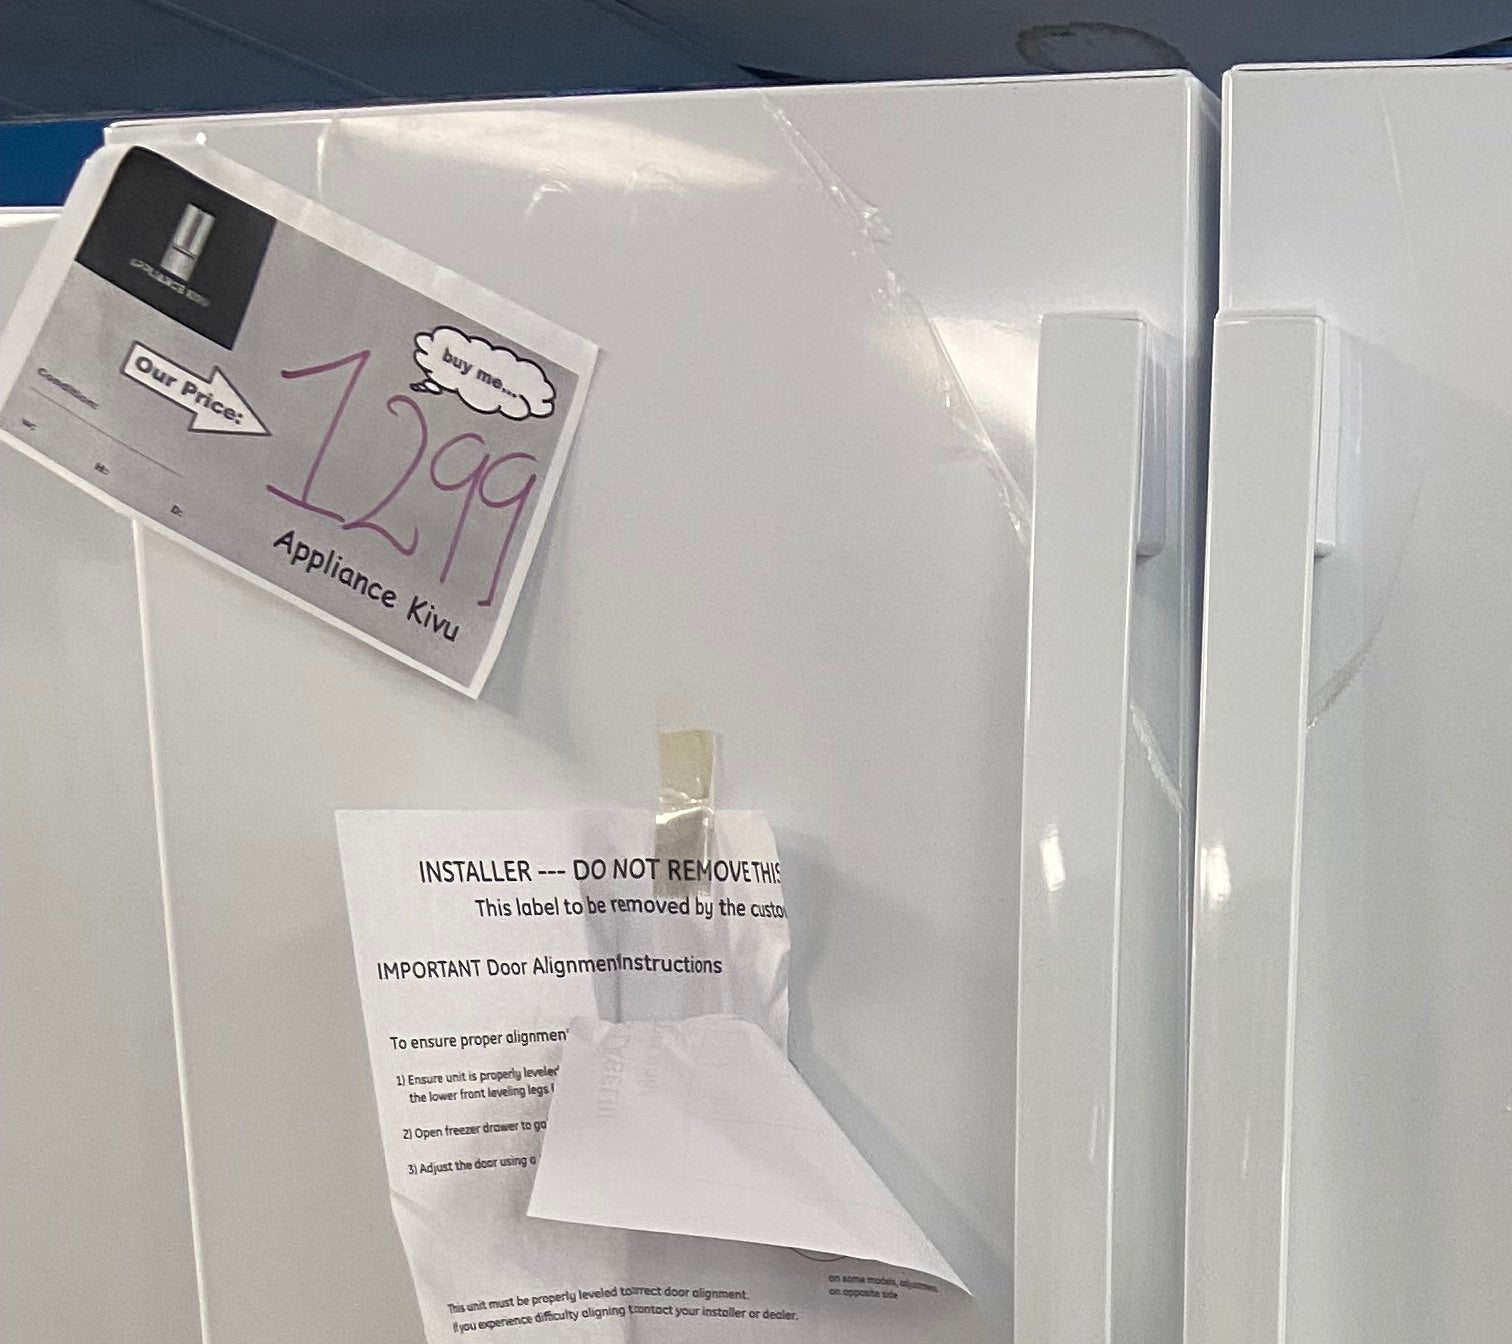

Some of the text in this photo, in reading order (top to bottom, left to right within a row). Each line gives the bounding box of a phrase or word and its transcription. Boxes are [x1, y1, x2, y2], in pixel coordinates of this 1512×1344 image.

[442, 347, 474, 375] buy
[135, 356, 244, 426] Our Price:
[266, 349, 540, 607] 1299
[273, 530, 461, 643] Appliance Kivu
[419, 860, 533, 883] INSTALLER
[573, 858, 607, 881] DO
[613, 857, 661, 880] NOT
[668, 859, 751, 882] REMOVE
[474, 895, 789, 919] This label to be removed by the custo
[377, 959, 481, 980] IMPORTANT
[487, 957, 528, 976] Door
[390, 1028, 570, 1050] To ensure proper alignmen
[408, 1073, 443, 1086] Ensure
[446, 1071, 466, 1083] unit
[468, 1071, 478, 1081] is
[480, 1066, 522, 1083] properly
[409, 1091, 427, 1103] the
[429, 1091, 459, 1103] lower
[460, 1088, 486, 1100] front
[487, 1085, 526, 1099] leveling
[528, 1083, 549, 1097] legs
[415, 1126, 443, 1140] Open
[445, 1123, 481, 1137] freezer
[483, 1121, 519, 1133] drawer
[521, 1120, 532, 1131] to
[419, 1160, 453, 1176] Adjust
[455, 1159, 473, 1171] the
[474, 1157, 498, 1169] door
[500, 1155, 528, 1169] using
[447, 1303, 466, 1315] This
[467, 1300, 487, 1312] unit
[488, 1297, 515, 1310] must
[516, 1295, 529, 1306] be
[531, 1291, 577, 1308] properly
[578, 1286, 618, 1300] leveled
[664, 1286, 690, 1297] door
[692, 1287, 750, 1301] alignment.
[460, 1321, 477, 1334] you
[478, 1315, 533, 1331] experience
[534, 1310, 579, 1324] difficulty
[581, 1304, 626, 1320] aligning
[675, 1306, 701, 1318] your
[702, 1306, 747, 1319] installer
[749, 1309, 760, 1319] or
[762, 1308, 800, 1321] dealer.
